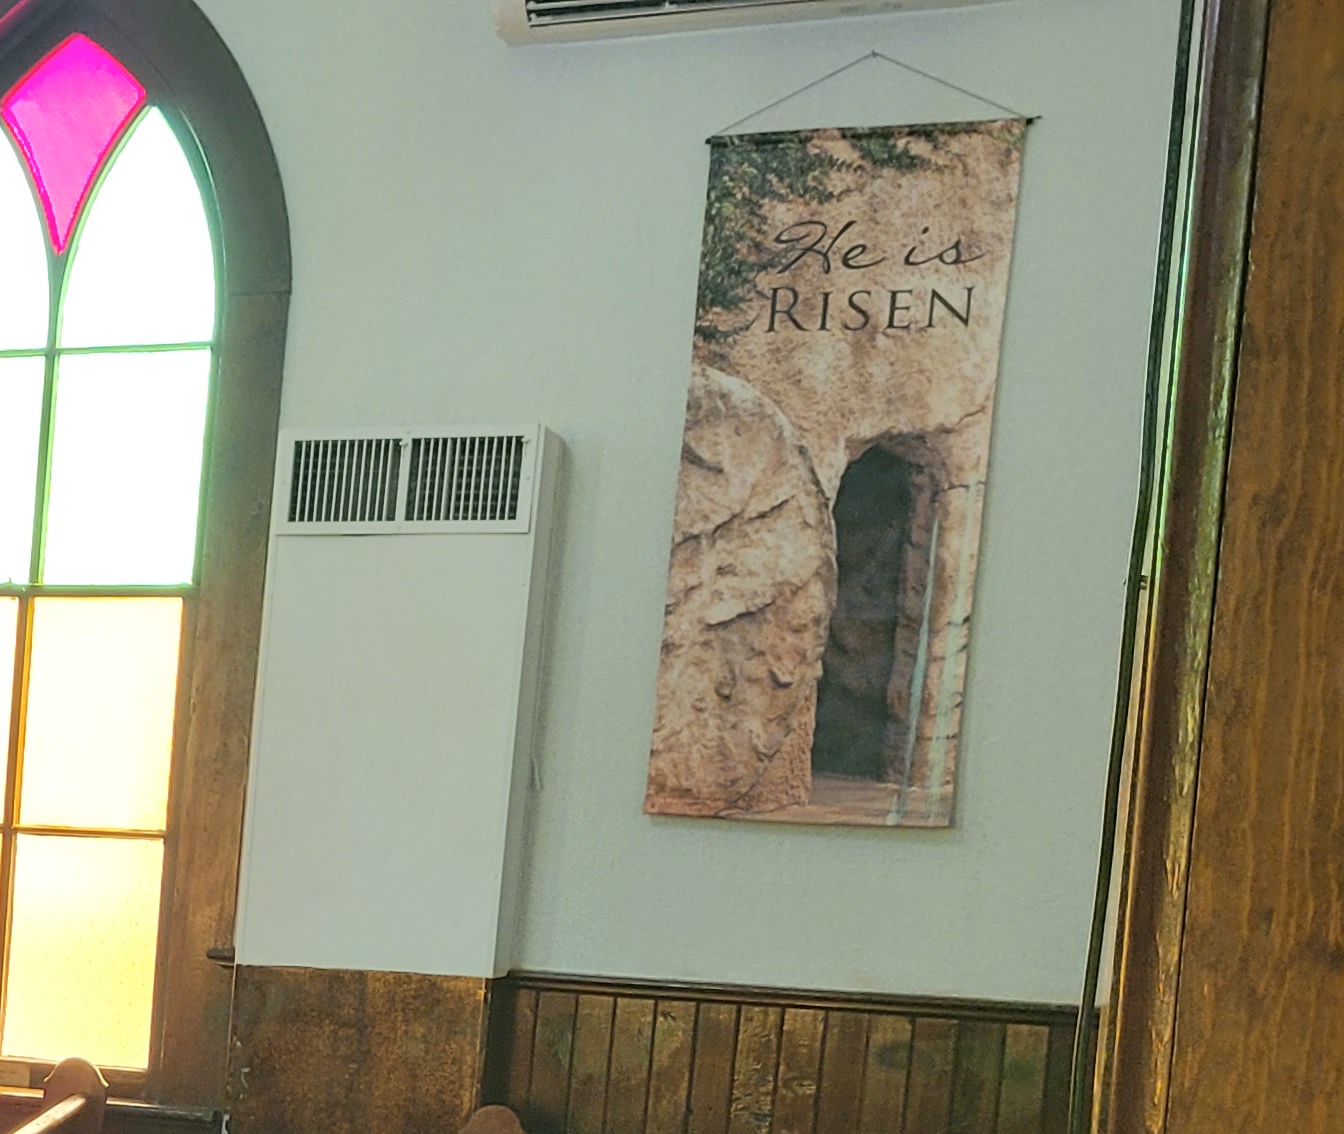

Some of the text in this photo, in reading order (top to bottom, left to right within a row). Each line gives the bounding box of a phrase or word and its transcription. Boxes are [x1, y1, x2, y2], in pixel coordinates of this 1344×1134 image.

[773, 219, 986, 275] He is
[765, 285, 976, 334] RISEN
